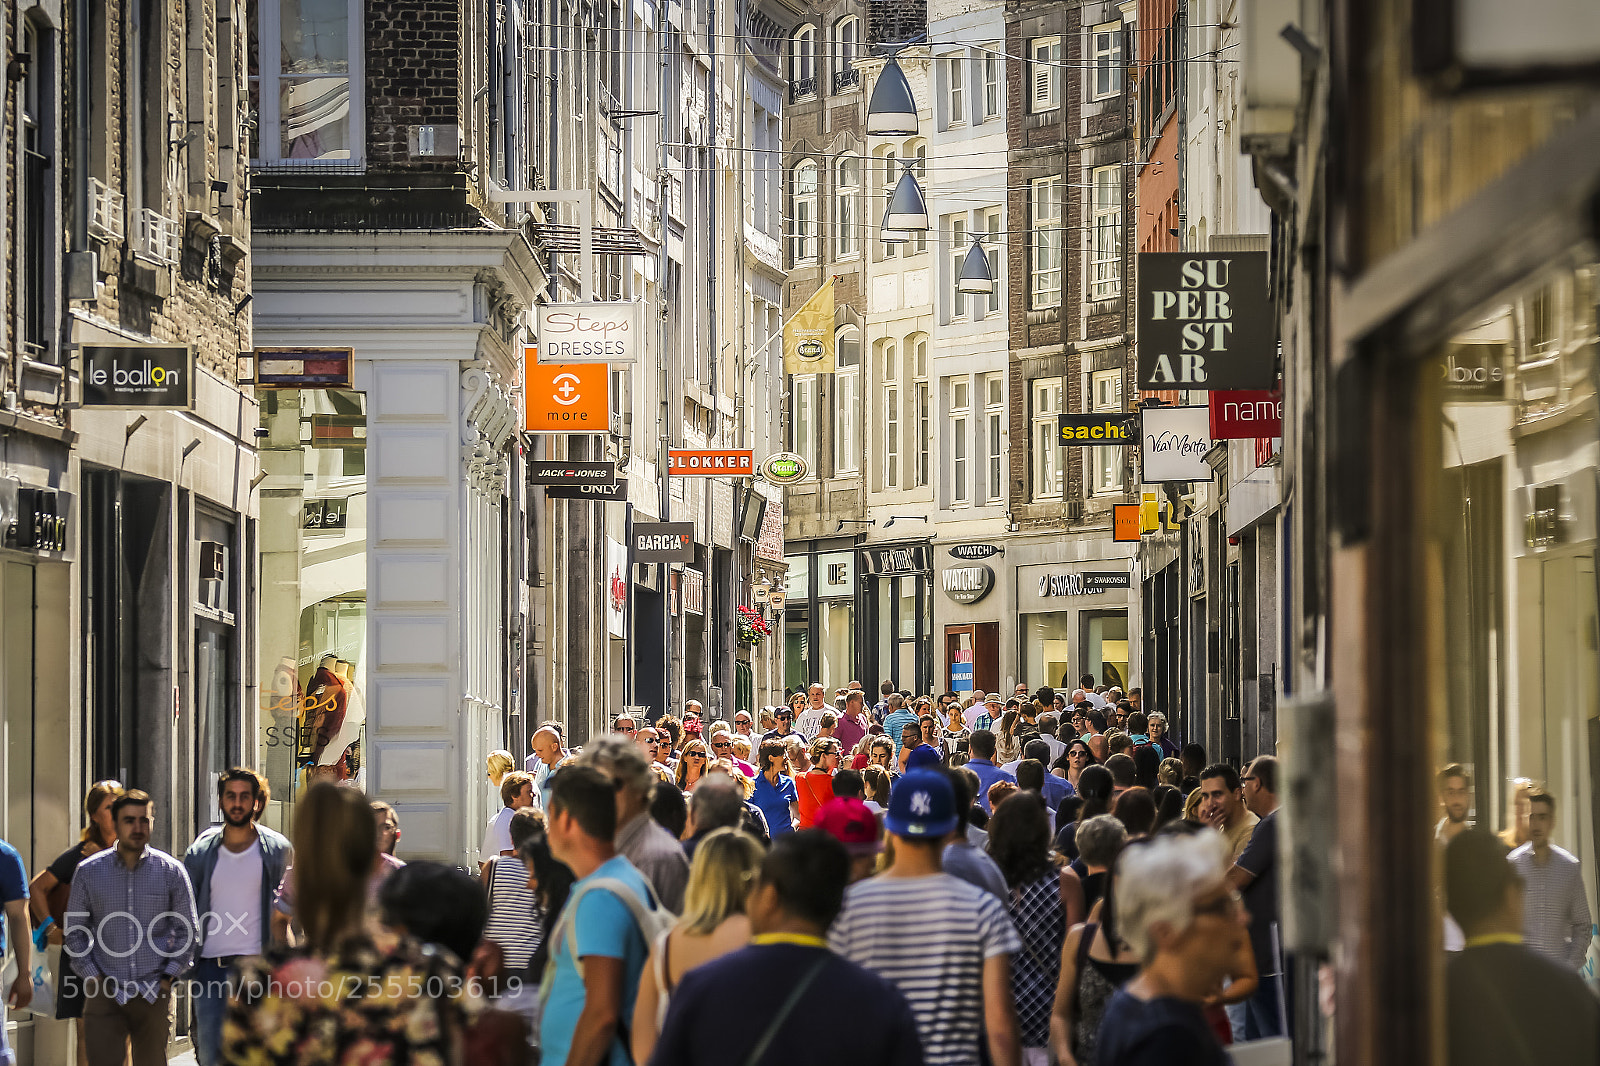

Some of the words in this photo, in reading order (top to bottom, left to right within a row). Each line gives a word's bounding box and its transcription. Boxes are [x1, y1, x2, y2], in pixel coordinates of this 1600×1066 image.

[1182, 259, 1232, 288] SU
[1151, 290, 1233, 320] PER
[543, 312, 629, 340] Steps
[1181, 322, 1233, 351] ST
[548, 340, 626, 356] DRESSES
[89, 359, 107, 385] le
[113, 359, 179, 387] ballon
[1148, 353, 1208, 383] AR
[547, 411, 588, 421] more
[538, 469, 565, 477] JACK
[574, 469, 607, 478] JONES
[771, 462, 799, 473] Brand
[580, 484, 620, 495] ONLY
[957, 545, 993, 556] WATCH!
[942, 567, 983, 591] WATCH!
